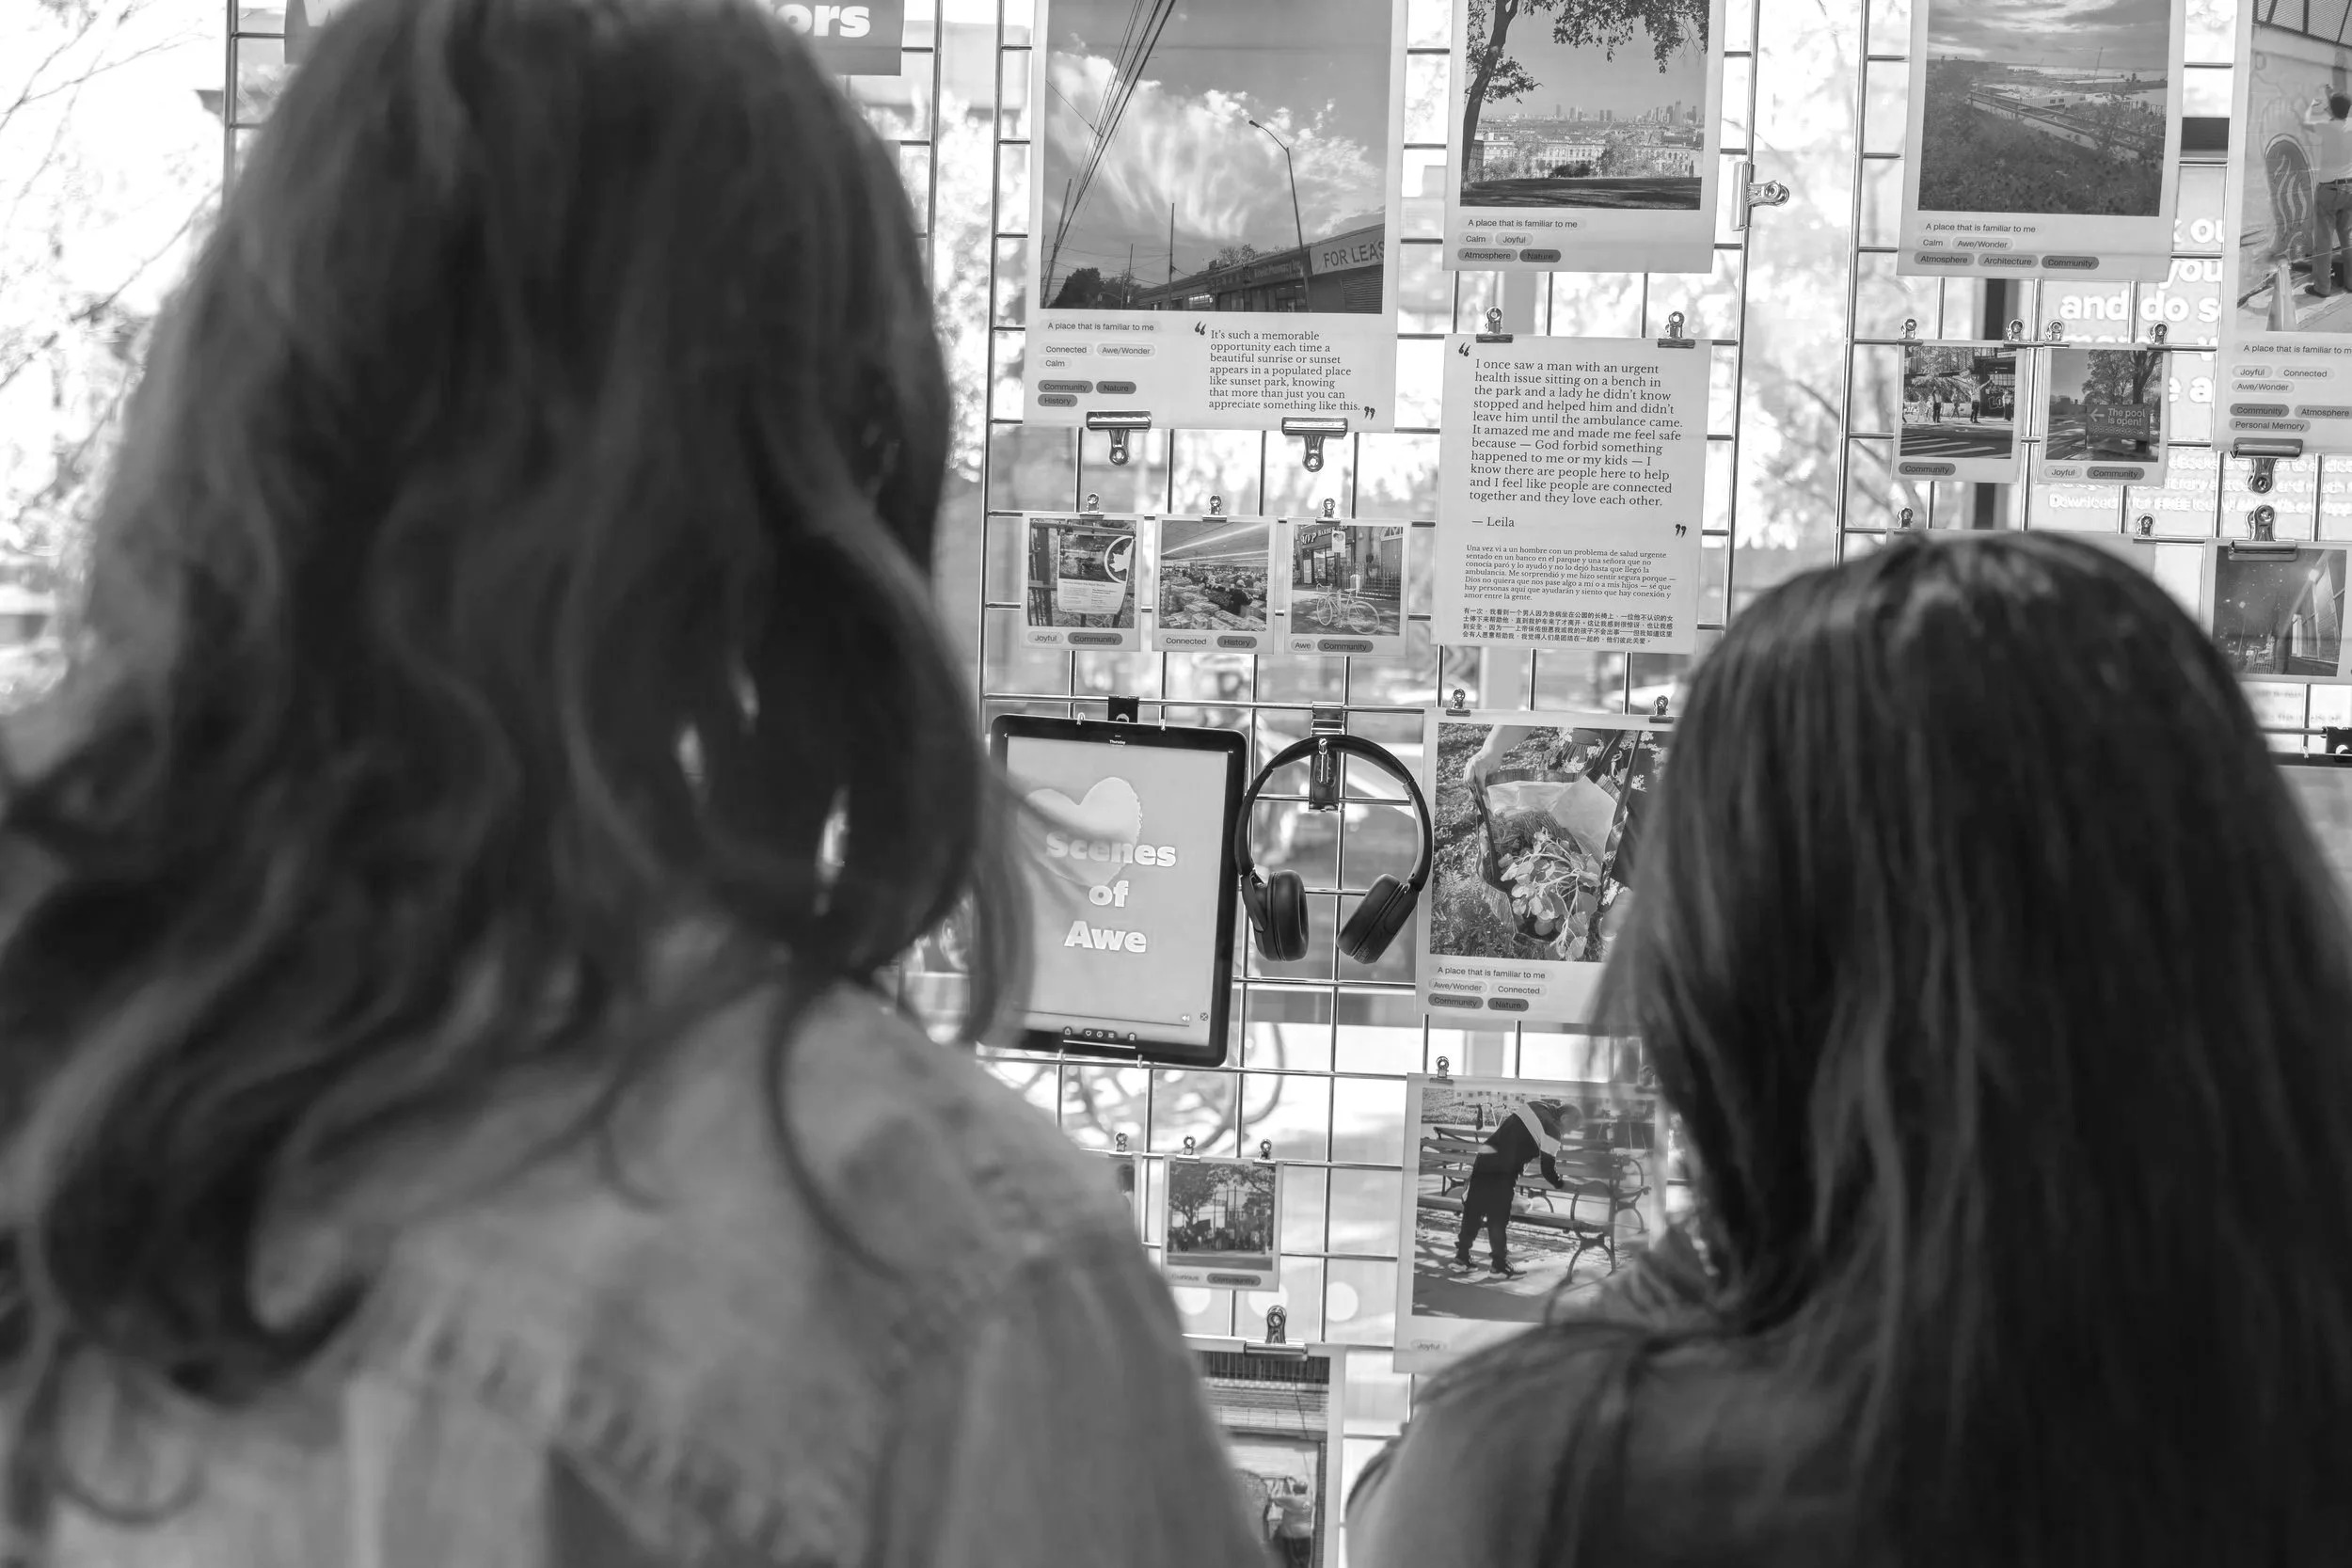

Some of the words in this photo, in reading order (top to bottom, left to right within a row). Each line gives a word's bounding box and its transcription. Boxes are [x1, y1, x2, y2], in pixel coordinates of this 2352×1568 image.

[771, 4, 870, 38] ors
[1475, 219, 1498, 229] place
[1525, 219, 1553, 228] familiar
[1933, 223, 1955, 232] place
[1982, 224, 2011, 232] familiar
[1502, 235, 1526, 245] Joyful
[1923, 238, 1944, 247] Calm
[1957, 239, 2008, 249] Awe/Wonder
[1324, 249, 1348, 268] FOR
[1465, 251, 1511, 261] Atmosphere
[1527, 252, 1553, 261] Nature
[1920, 254, 1967, 265] Atmosphere
[1984, 257, 2032, 266] Architecture
[2048, 257, 2092, 268] Community
[2059, 290, 2130, 320] and
[2139, 290, 2189, 322] do
[1056, 323, 1076, 332] place
[1103, 323, 1131, 331] familiar
[1211, 330, 1226, 340] It's
[1228, 330, 1250, 340] such
[1262, 331, 1320, 341] memorable
[1045, 345, 1087, 354] Connected
[1102, 346, 1151, 356] Awe/Wonder
[1210, 341, 1272, 354] opportunity
[1274, 342, 1296, 352] each
[1299, 343, 1323, 353] time
[2252, 344, 2275, 355] place
[2302, 345, 2332, 354] familiar
[1045, 358, 1065, 368] Calm
[1210, 354, 1254, 363] beautiful
[1258, 355, 1294, 363] sunrise
[1310, 356, 1341, 364] sunset
[1210, 367, 1248, 377] appears
[1251, 366, 1262, 374] in
[1272, 366, 1323, 378] populated
[1326, 367, 1352, 378] place
[1476, 359, 1480, 369] I
[1576, 362, 1600, 372] with
[1621, 364, 1659, 377] urgent
[2240, 369, 2265, 377] Joyful
[1210, 376, 1228, 386] like
[1230, 377, 1261, 386] sunset
[1264, 377, 1289, 389] park,
[1292, 377, 1336, 389] knowing
[1475, 372, 1510, 383] health
[1514, 373, 1542, 384] issue
[1545, 374, 1581, 388] sitting
[1612, 376, 1646, 387] bench
[1649, 378, 1661, 388] in
[1043, 382, 1088, 392] Community
[1103, 383, 1129, 392] Nature
[2237, 383, 2289, 391] Awe/Wonder
[1209, 388, 1229, 397] that
[1261, 388, 1283, 398] than
[1284, 389, 1304, 401] just
[1306, 391, 1326, 401] you
[1474, 386, 1493, 396] the
[1496, 386, 1521, 399] park
[1524, 387, 1546, 397] and
[1559, 388, 1583, 401] lady
[1586, 388, 1600, 399] he
[1603, 389, 1637, 400] didn't
[1640, 390, 1672, 401] know
[1043, 396, 1072, 405] History
[1208, 399, 1261, 411] appreciate
[1263, 400, 1317, 413] something
[1319, 401, 1337, 410] like
[1340, 402, 1360, 411] this.
[2237, 406, 2282, 416] Community
[2107, 408, 2123, 418] The
[2125, 408, 2145, 419] pool
[2107, 417, 2114, 425] is
[2116, 417, 2142, 427] open!
[2272, 422, 2304, 431] Memory
[1905, 465, 1949, 474] Community
[2051, 468, 2075, 477] Joyful
[2093, 469, 2137, 479] Community
[1486, 516, 1515, 528] Leila
[1511, 594, 1533, 603] gente.
[1074, 635, 1117, 643] Community
[1166, 636, 1206, 645] Connected
[1223, 638, 1250, 648] History
[1046, 832, 1176, 867] Scenes
[1089, 880, 1129, 908] of
[1063, 921, 1147, 953] Awe
[1445, 967, 1466, 977] place
[1468, 968, 1483, 976] that
[1493, 970, 1522, 978] familiar
[1434, 982, 1482, 991] Awe/Wonder
[1498, 986, 1540, 994] Connected
[1434, 997, 1477, 1008] Community
[1496, 1001, 1521, 1009] Nature
